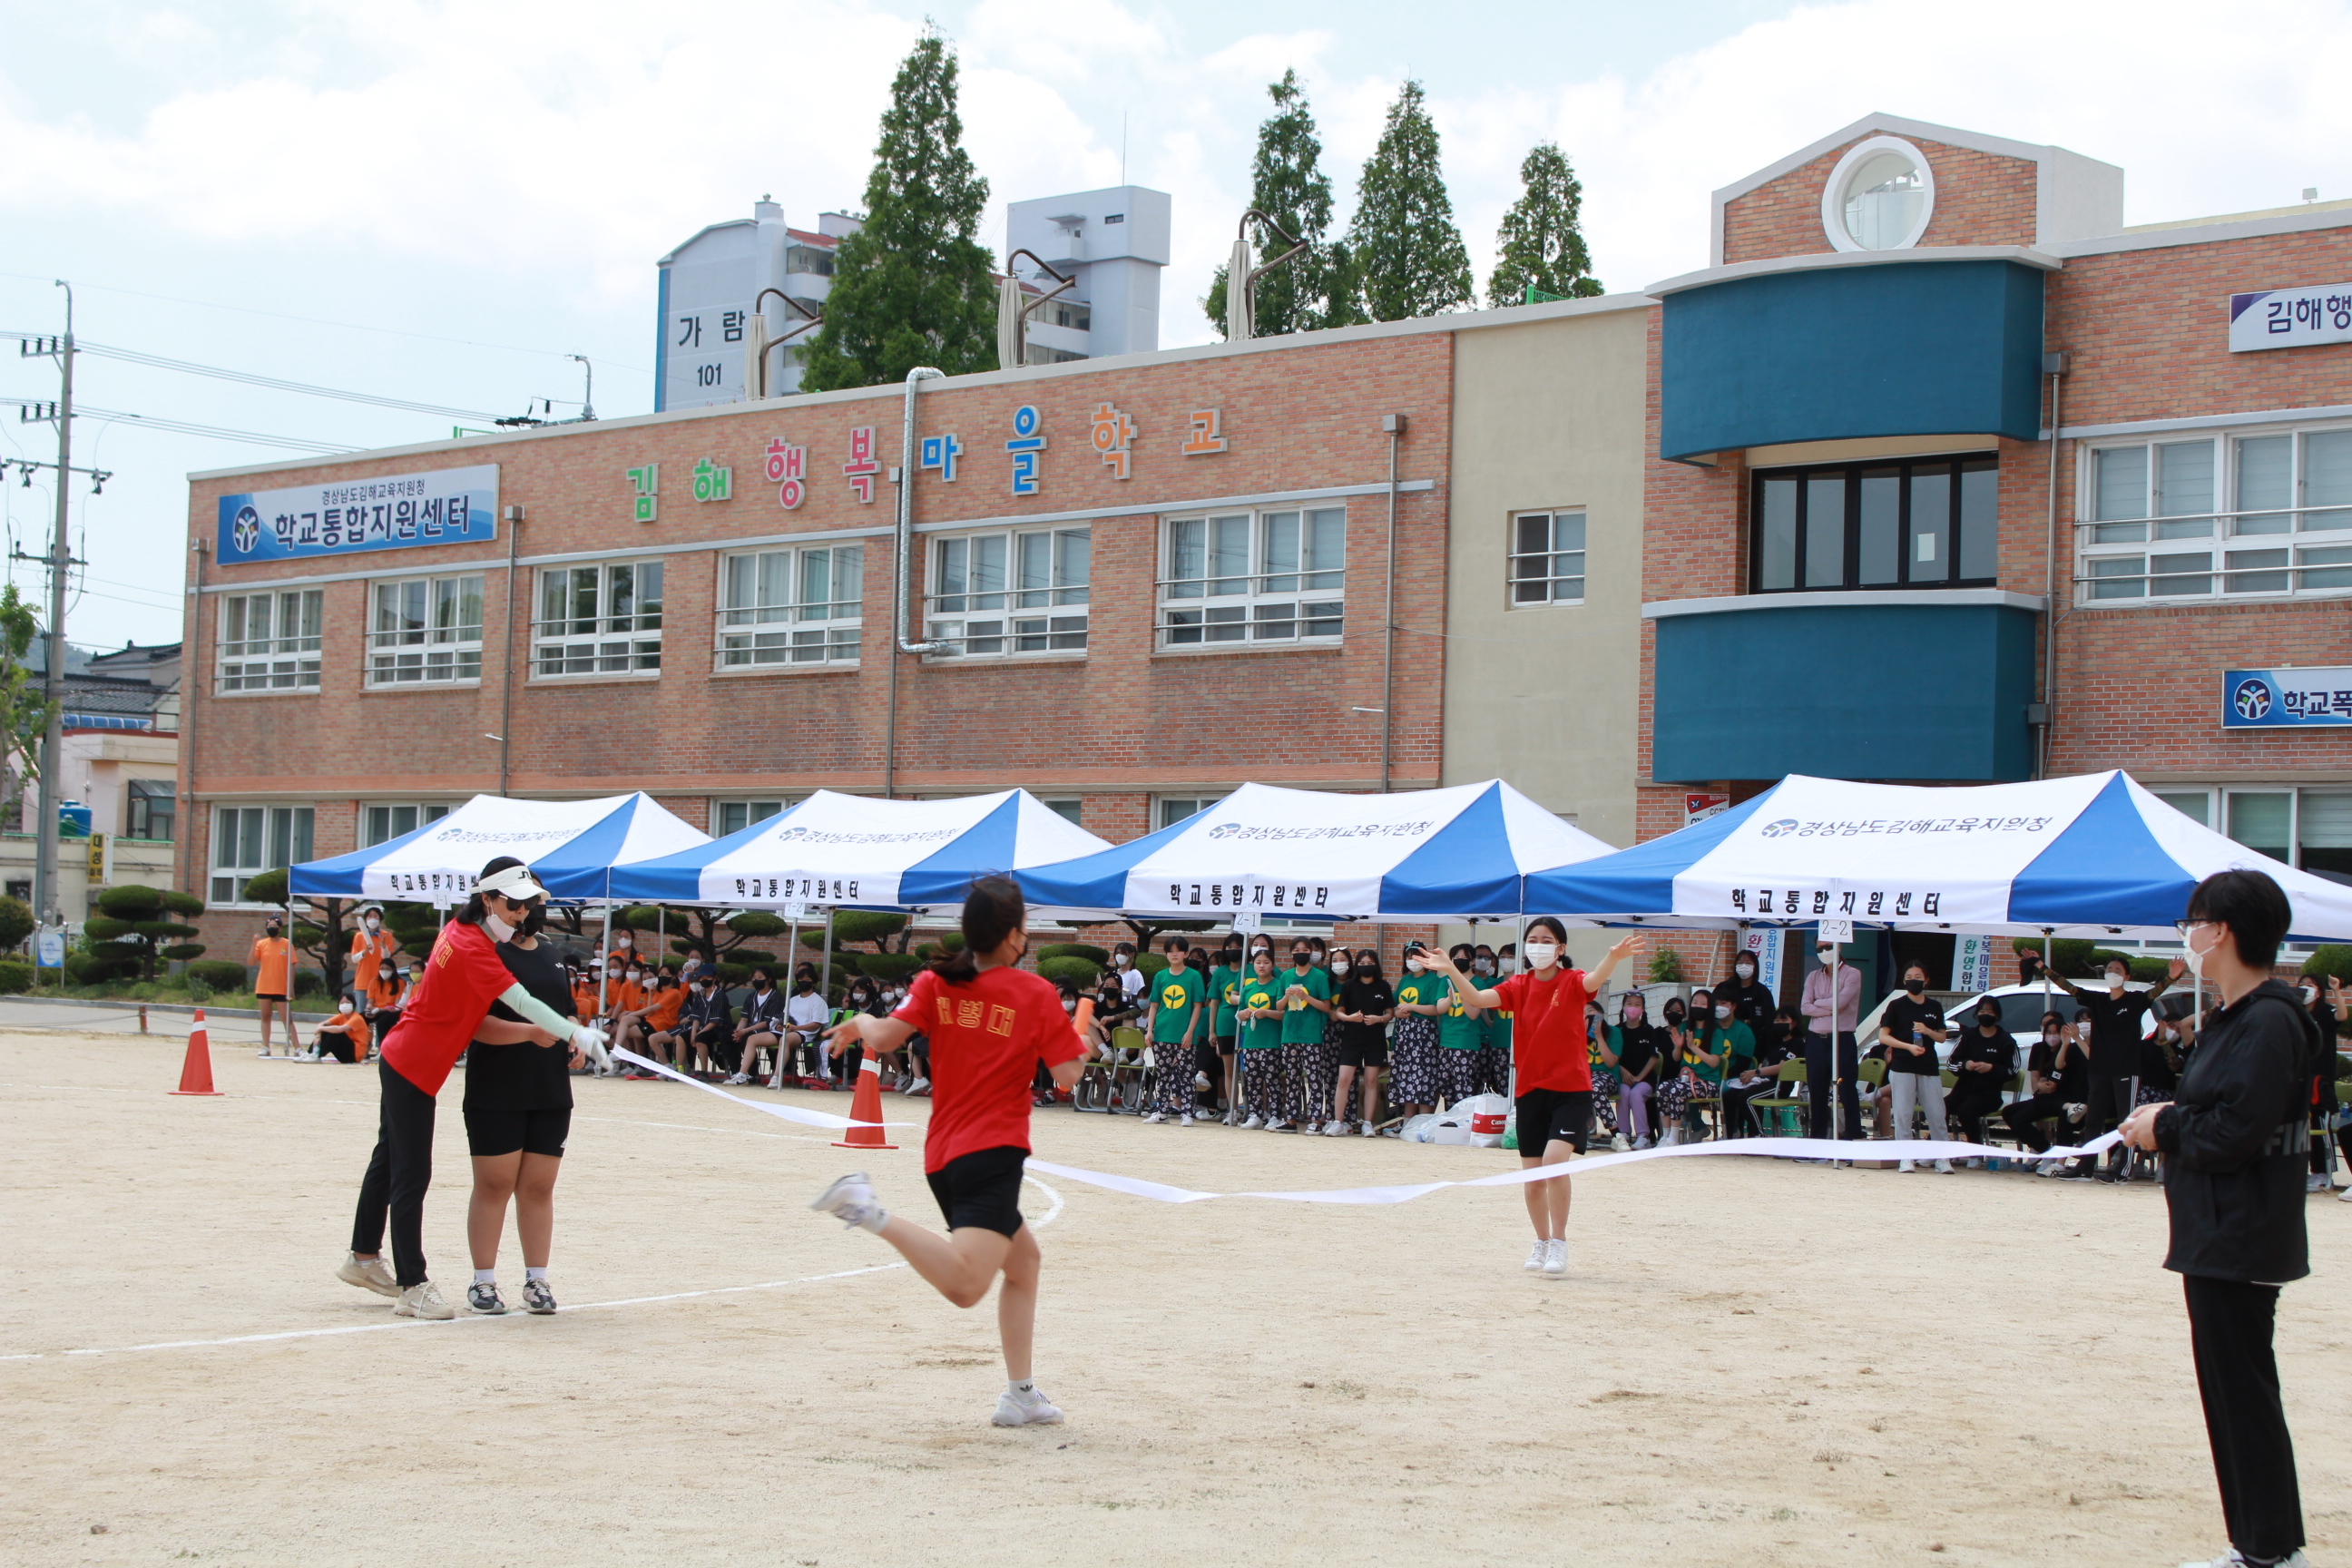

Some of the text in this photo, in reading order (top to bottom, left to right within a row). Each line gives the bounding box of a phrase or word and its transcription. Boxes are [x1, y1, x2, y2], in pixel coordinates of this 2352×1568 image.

[697, 363, 721, 387] 101
[321, 479, 426, 505] 경상남도김해교육지원청
[275, 495, 470, 552] 학교통합지원센터
[1238, 821, 1435, 840] 경상남도김해교육지원청
[1798, 817, 2053, 837] 경상남도김해교육지원청
[736, 878, 859, 899] 학교통합지원센터
[1170, 884, 1328, 907] 학교통합지원센터
[1731, 888, 1940, 916] 학교통합지원센터
[1237, 912, 1257, 927] 2-1
[1821, 919, 1848, 936] 2-2
